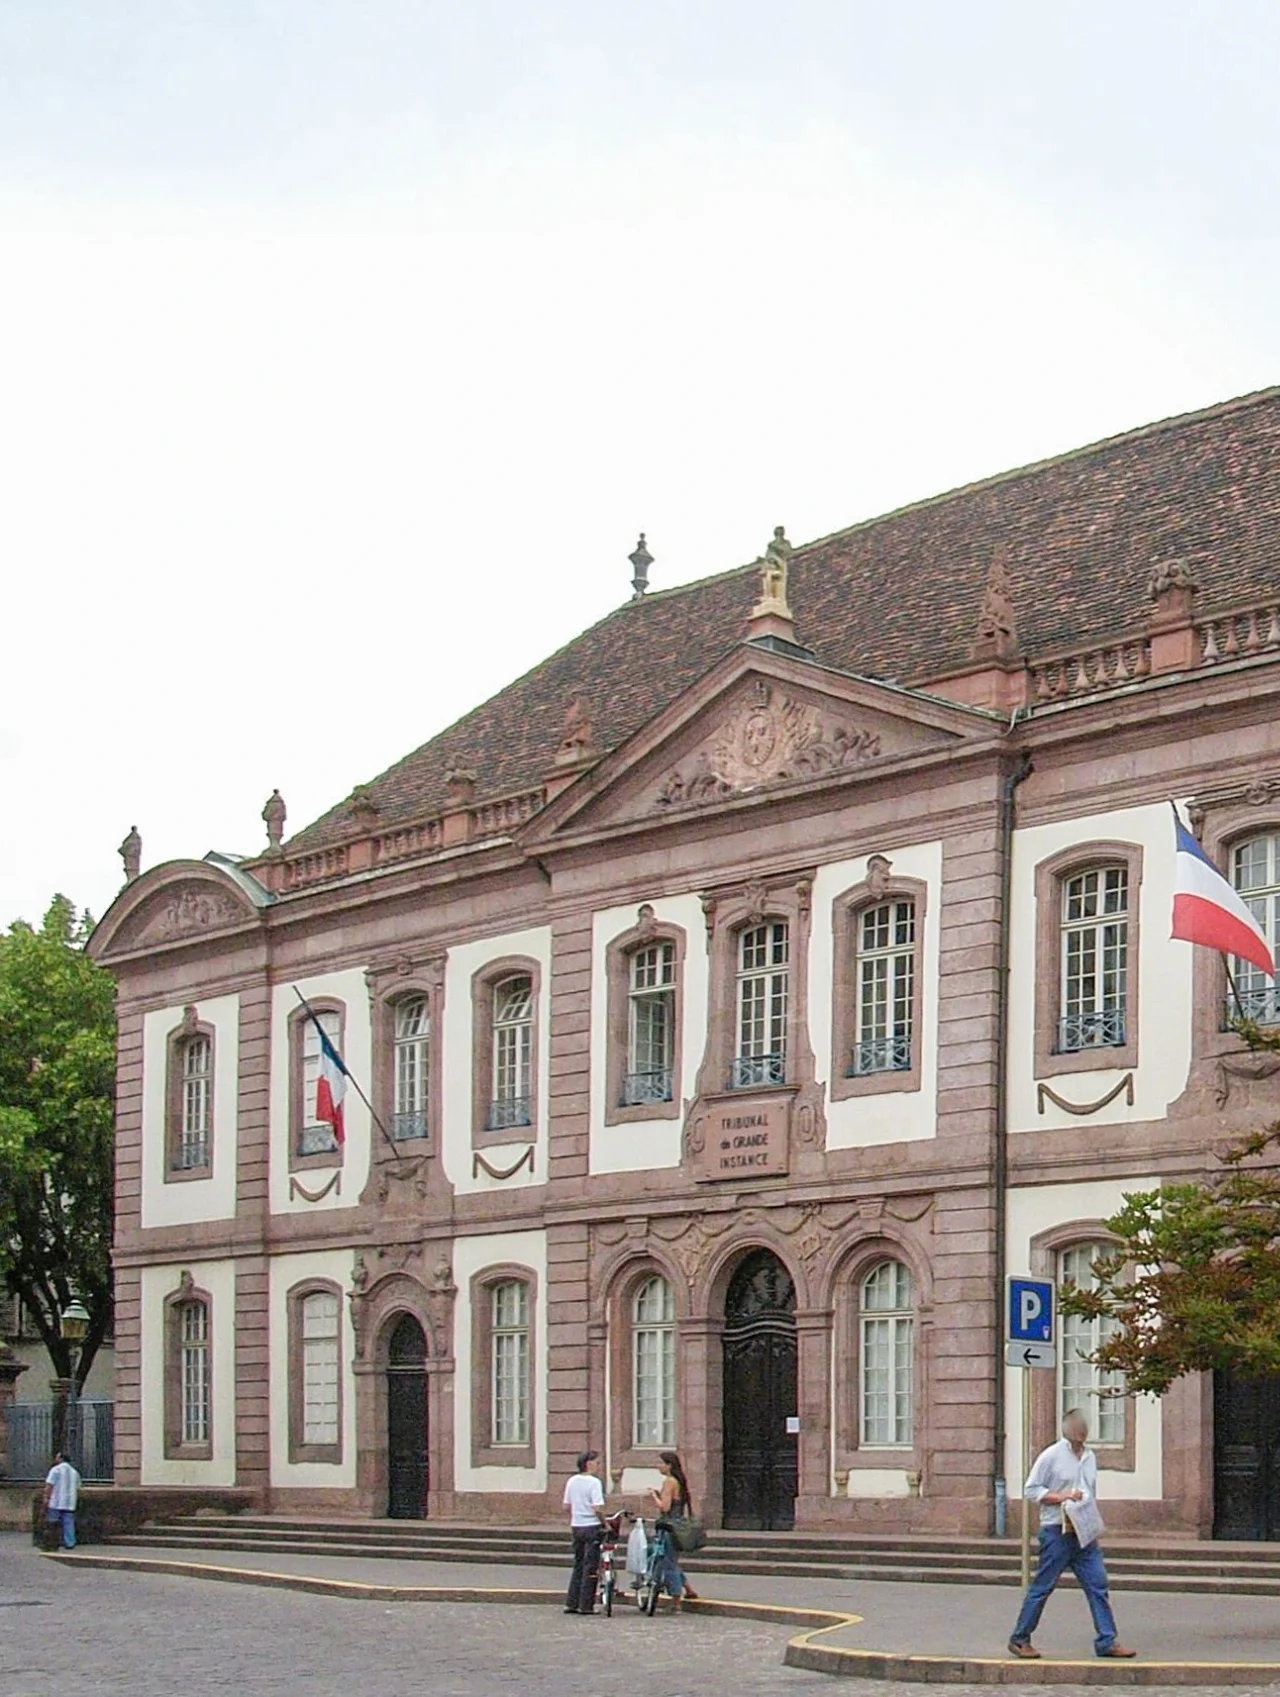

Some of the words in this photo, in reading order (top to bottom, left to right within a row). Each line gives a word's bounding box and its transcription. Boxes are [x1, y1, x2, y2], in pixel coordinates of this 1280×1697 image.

[722, 1114, 768, 1129] TRIBUNAL
[721, 1139, 731, 1149] de
[733, 1133, 768, 1148] GRANDE
[720, 1153, 768, 1168] INSTANCE
[1021, 1290, 1042, 1330] P
